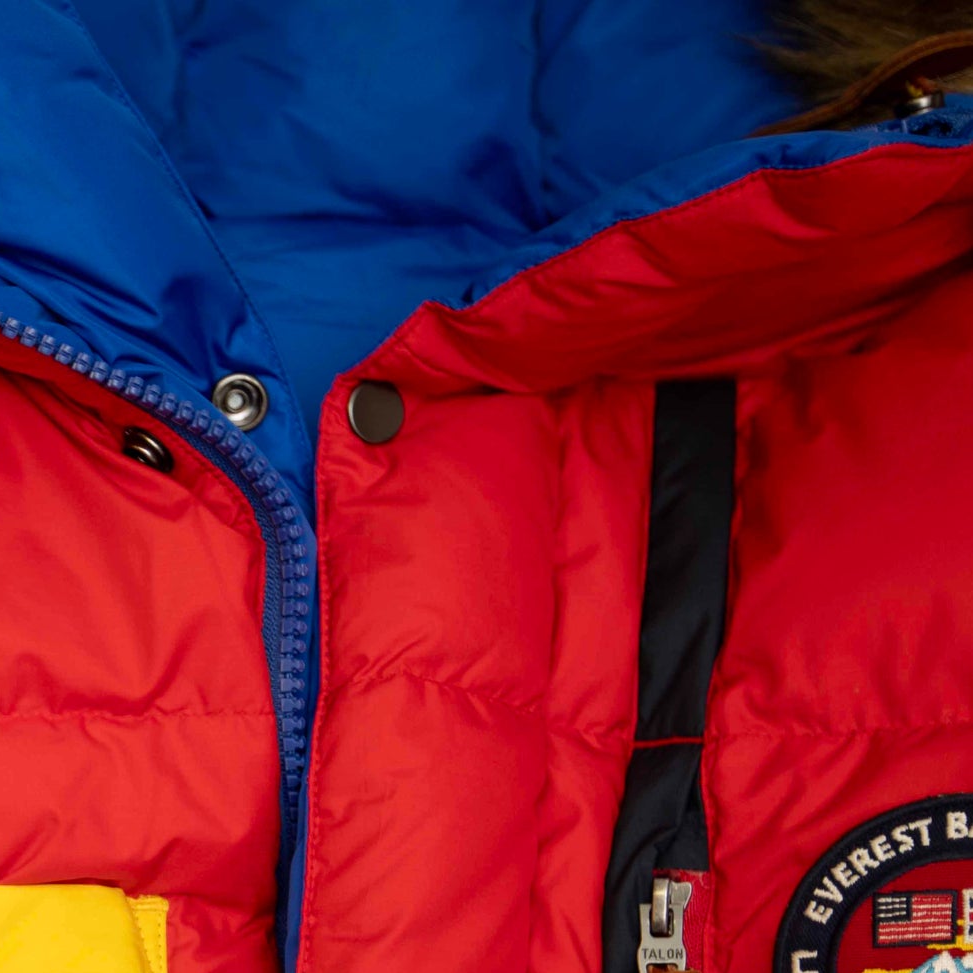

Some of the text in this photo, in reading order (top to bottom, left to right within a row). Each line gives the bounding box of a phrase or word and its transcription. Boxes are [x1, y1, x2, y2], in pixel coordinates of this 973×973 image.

[804, 811, 973, 924] EVEREST B
[641, 947, 684, 960] TALON
